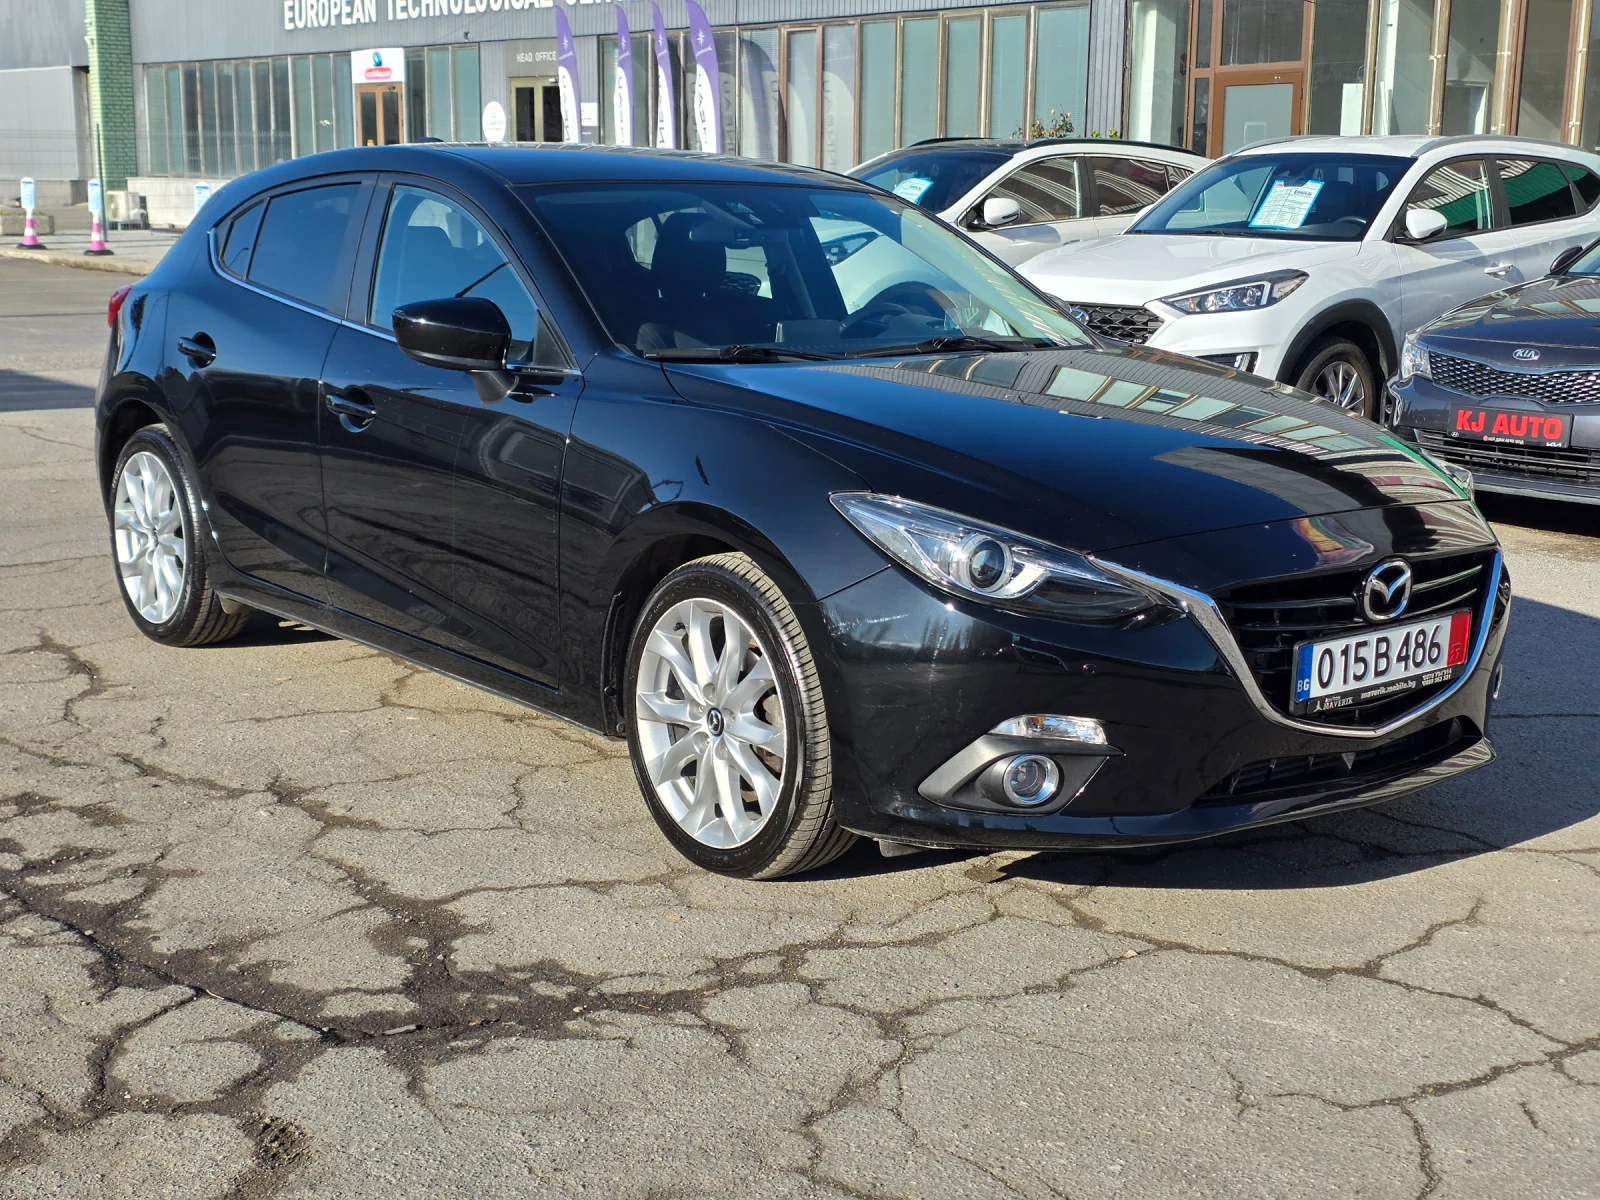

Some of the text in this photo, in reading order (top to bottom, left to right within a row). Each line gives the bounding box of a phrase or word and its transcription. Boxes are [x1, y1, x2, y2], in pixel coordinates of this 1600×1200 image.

[283, 0, 377, 30] EUROPEAN
[516, 52, 533, 63] HEAD
[535, 50, 557, 62] OFFICE
[1514, 349, 1537, 359] KIA
[1456, 409, 1563, 440] KJ AUTO
[1317, 624, 1442, 690] 015B486
[1297, 678, 1310, 692] BG
[1360, 680, 1416, 699] maverik.mobile.bg
[1323, 697, 1353, 710] MAVERIK
